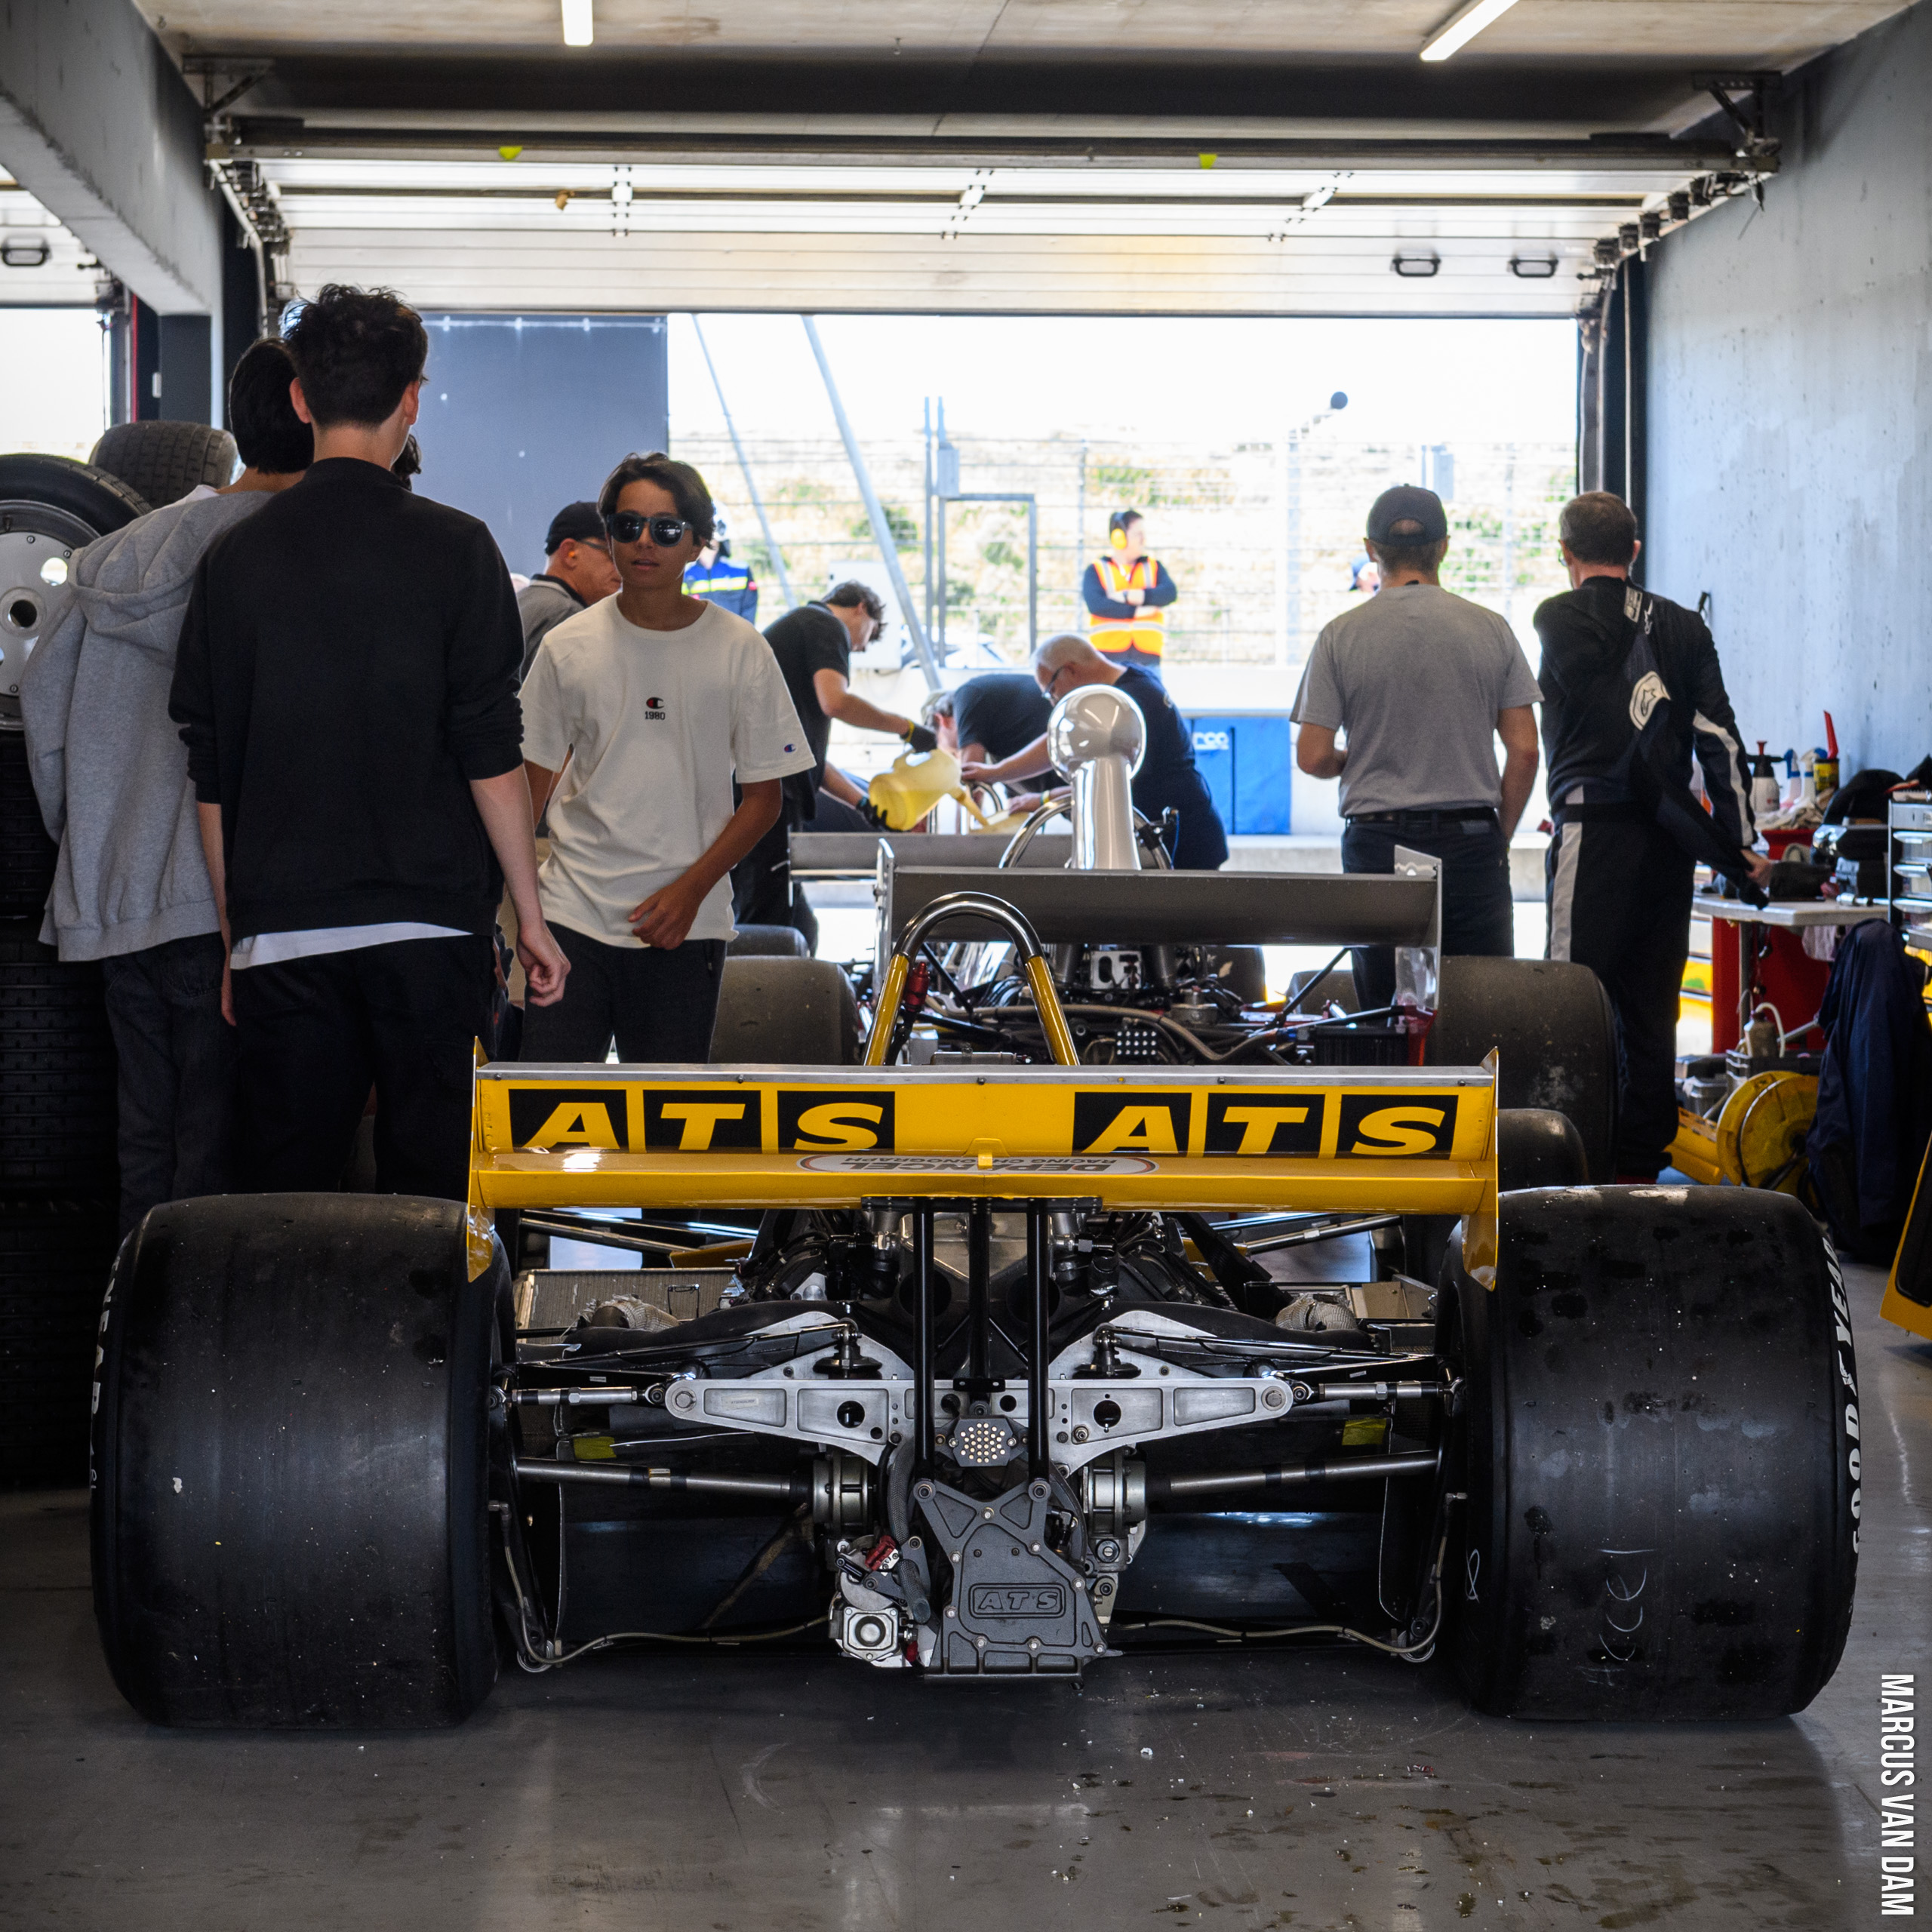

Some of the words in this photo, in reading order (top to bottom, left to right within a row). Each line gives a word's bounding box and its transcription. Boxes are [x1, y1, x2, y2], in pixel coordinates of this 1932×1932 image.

[645, 711, 666, 721] 1980
[522, 1102, 884, 1152] ATS
[1081, 1105, 1446, 1155] ATS
[978, 1591, 1059, 1611] ATS
